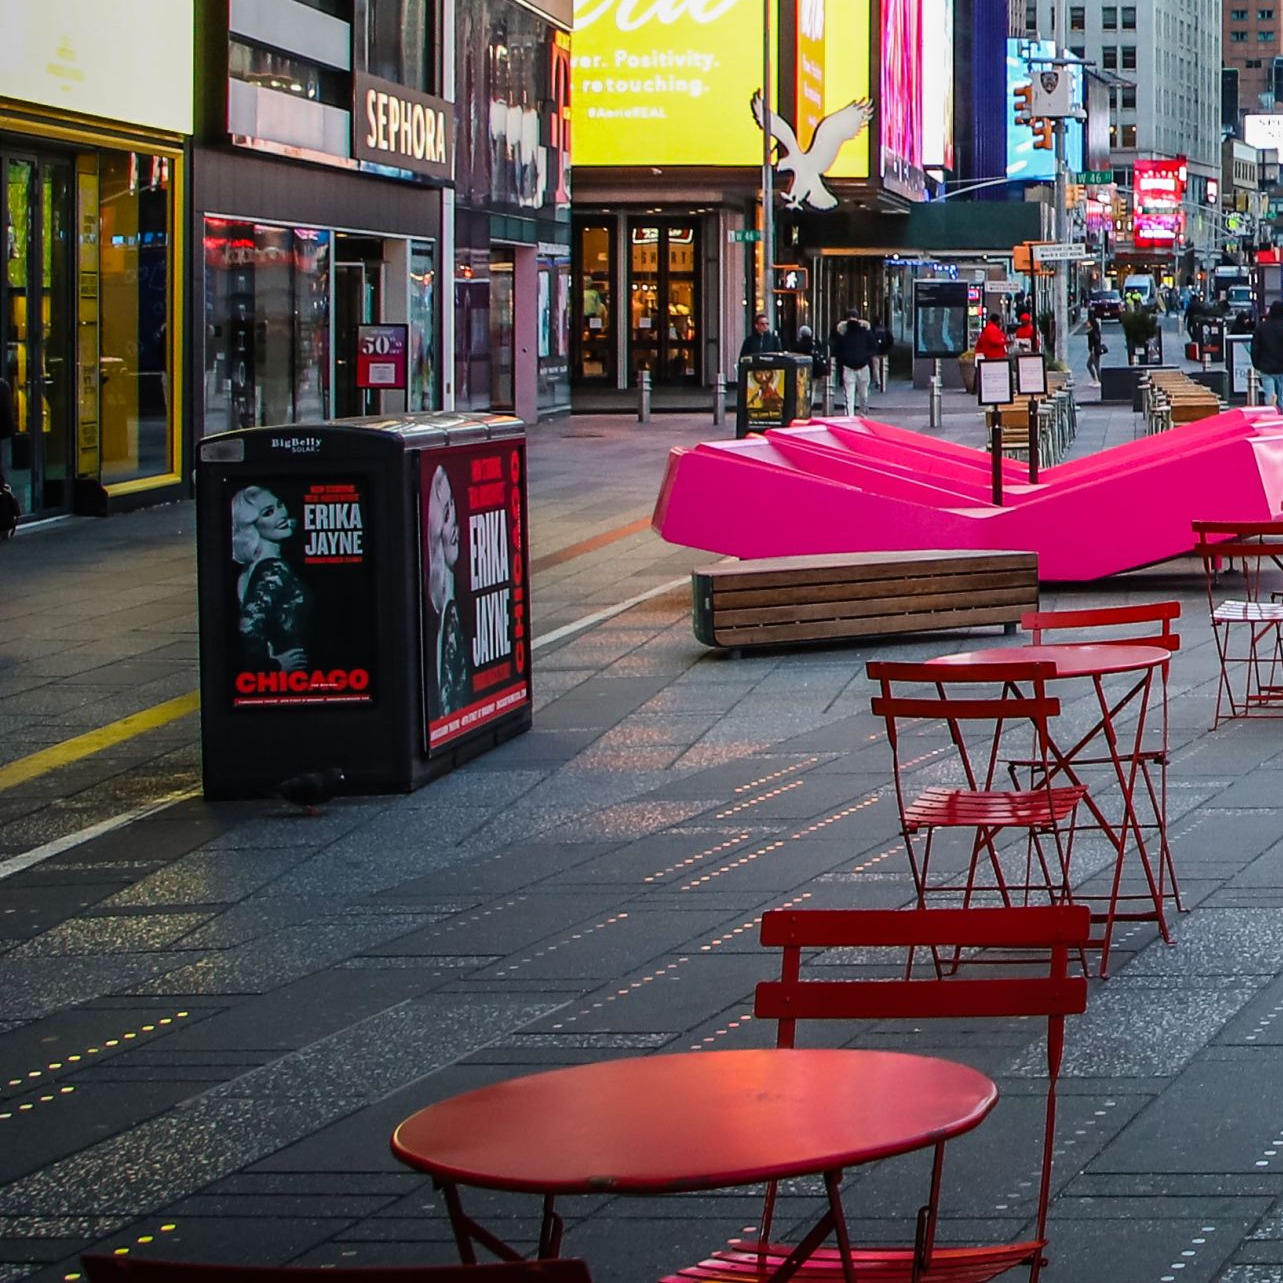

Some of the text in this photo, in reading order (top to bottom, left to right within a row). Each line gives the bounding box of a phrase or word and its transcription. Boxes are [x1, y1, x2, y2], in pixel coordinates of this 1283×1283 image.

[615, 50, 720, 71] Positivity.
[583, 76, 709, 97] retouching.
[588, 107, 668, 119] #AerieREAL
[367, 89, 446, 165] SEPHORA
[1078, 174, 1102, 183] W 46
[272, 437, 322, 449] BigBelly
[304, 503, 363, 530] ERIKA
[305, 531, 364, 556] JAYNE
[469, 509, 510, 592] ERIKA
[473, 588, 511, 667] JAYNE
[236, 670, 370, 693] CHICAGO
